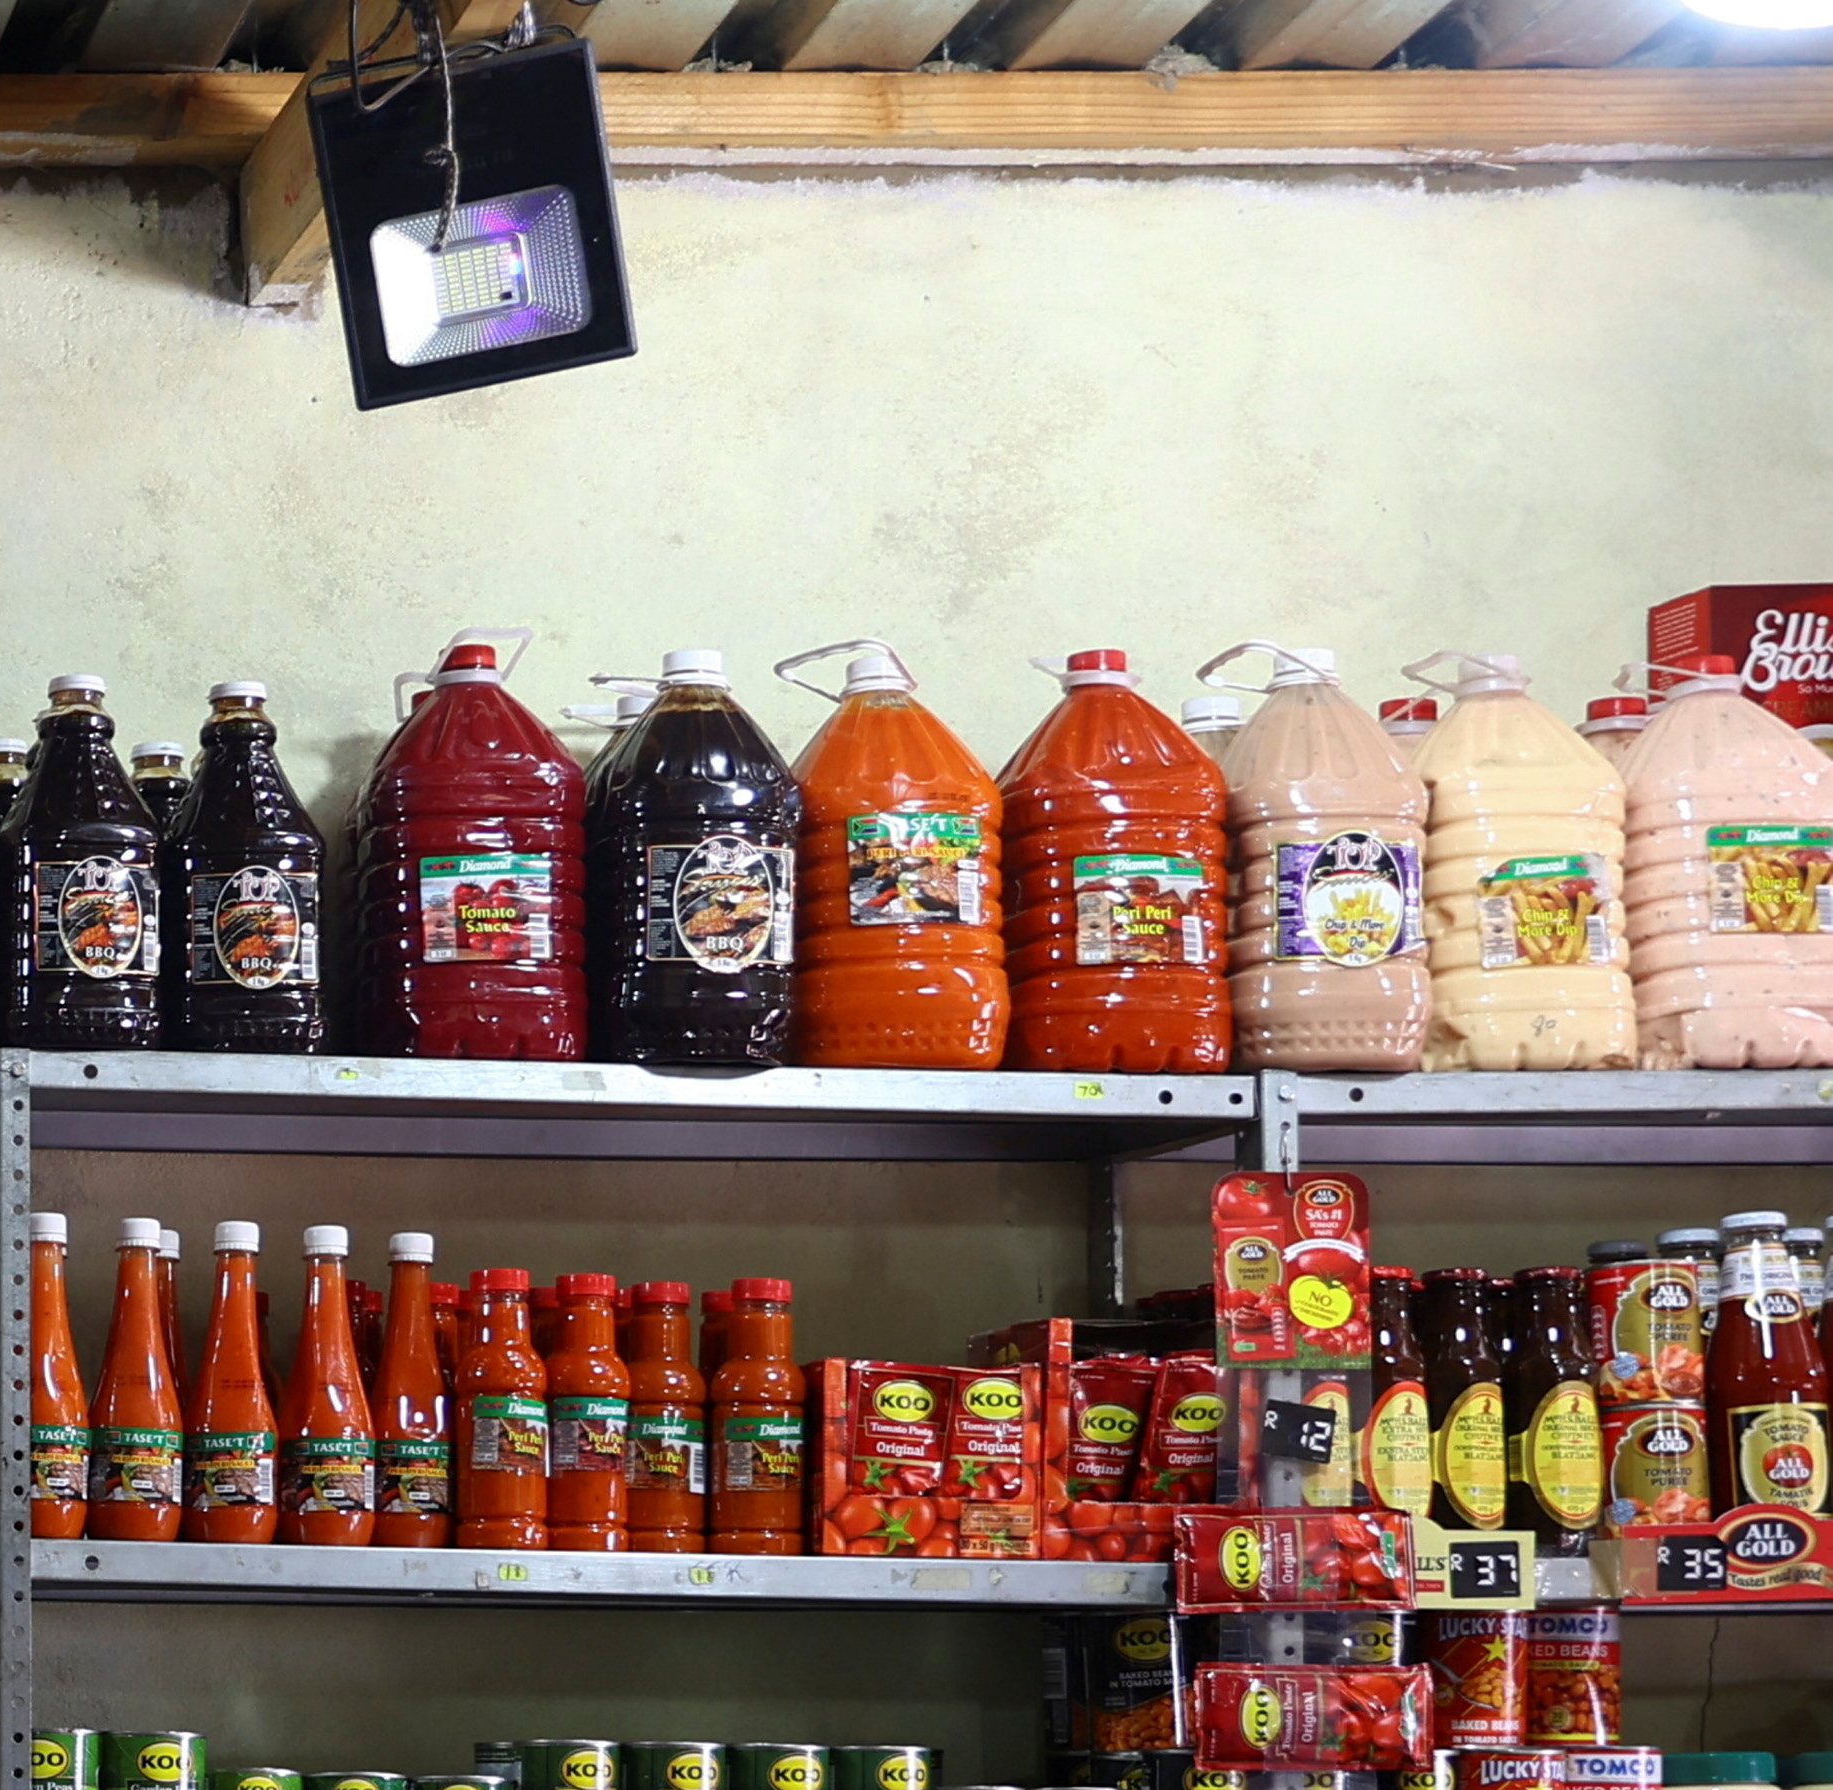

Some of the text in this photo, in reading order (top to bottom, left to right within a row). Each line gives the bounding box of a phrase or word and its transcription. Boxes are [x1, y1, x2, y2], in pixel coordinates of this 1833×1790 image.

[1750, 608, 1833, 653] Elli
[459, 858, 512, 873] Diamond
[459, 905, 516, 921] Tomato
[1112, 906, 1172, 922] Peri Peri
[466, 919, 510, 933] Sauce
[1122, 921, 1165, 936] Sauce
[85, 946, 116, 959] BBQ
[1656, 1283, 1684, 1297] ALL
[1649, 1294, 1689, 1309] GOLD
[880, 1392, 932, 1411] KOO
[871, 1422, 933, 1438] Tomato Paste
[1300, 1421, 1330, 1454] 12
[204, 1435, 244, 1450] TASE'T
[876, 1441, 926, 1457] Original
[1745, 1522, 1788, 1542] ALL
[1736, 1536, 1797, 1559] GOLD
[1476, 1554, 1517, 1587] 37
[1684, 1548, 1724, 1580] 35
[1728, 1568, 1822, 1587] Tastes real good
[1575, 1757, 1655, 1778] TOMCO
